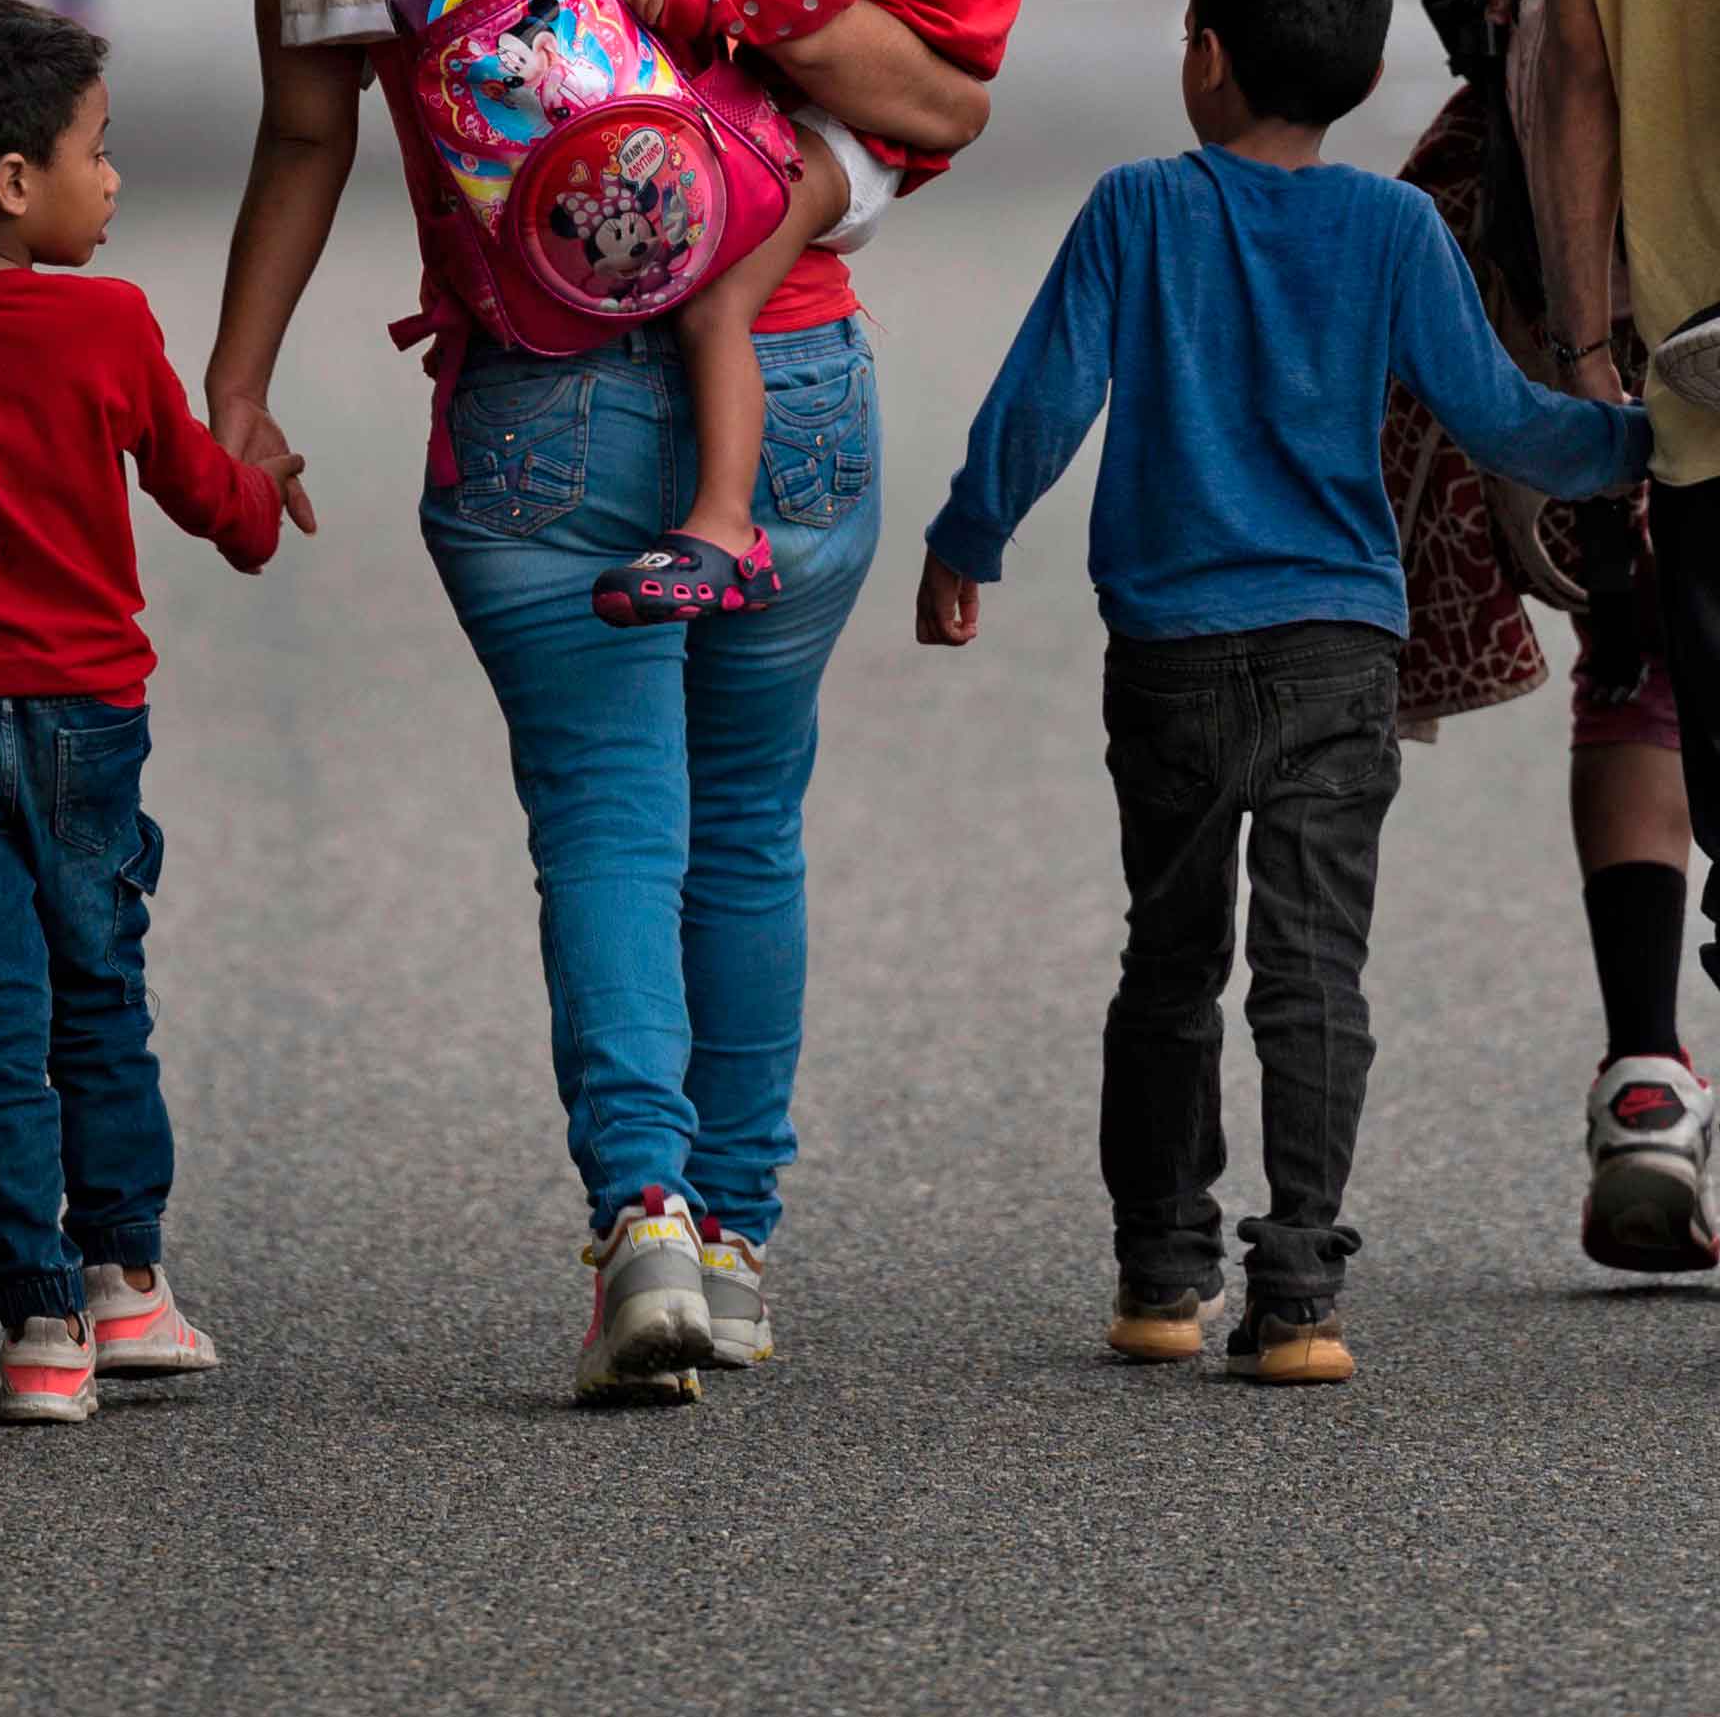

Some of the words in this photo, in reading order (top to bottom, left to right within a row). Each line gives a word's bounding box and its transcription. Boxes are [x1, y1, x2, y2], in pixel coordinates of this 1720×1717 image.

[622, 141, 644, 165] READY
[627, 142, 663, 179] ANYTHING
[632, 1221, 682, 1245] FILA
[702, 1247, 737, 1272] ILA
